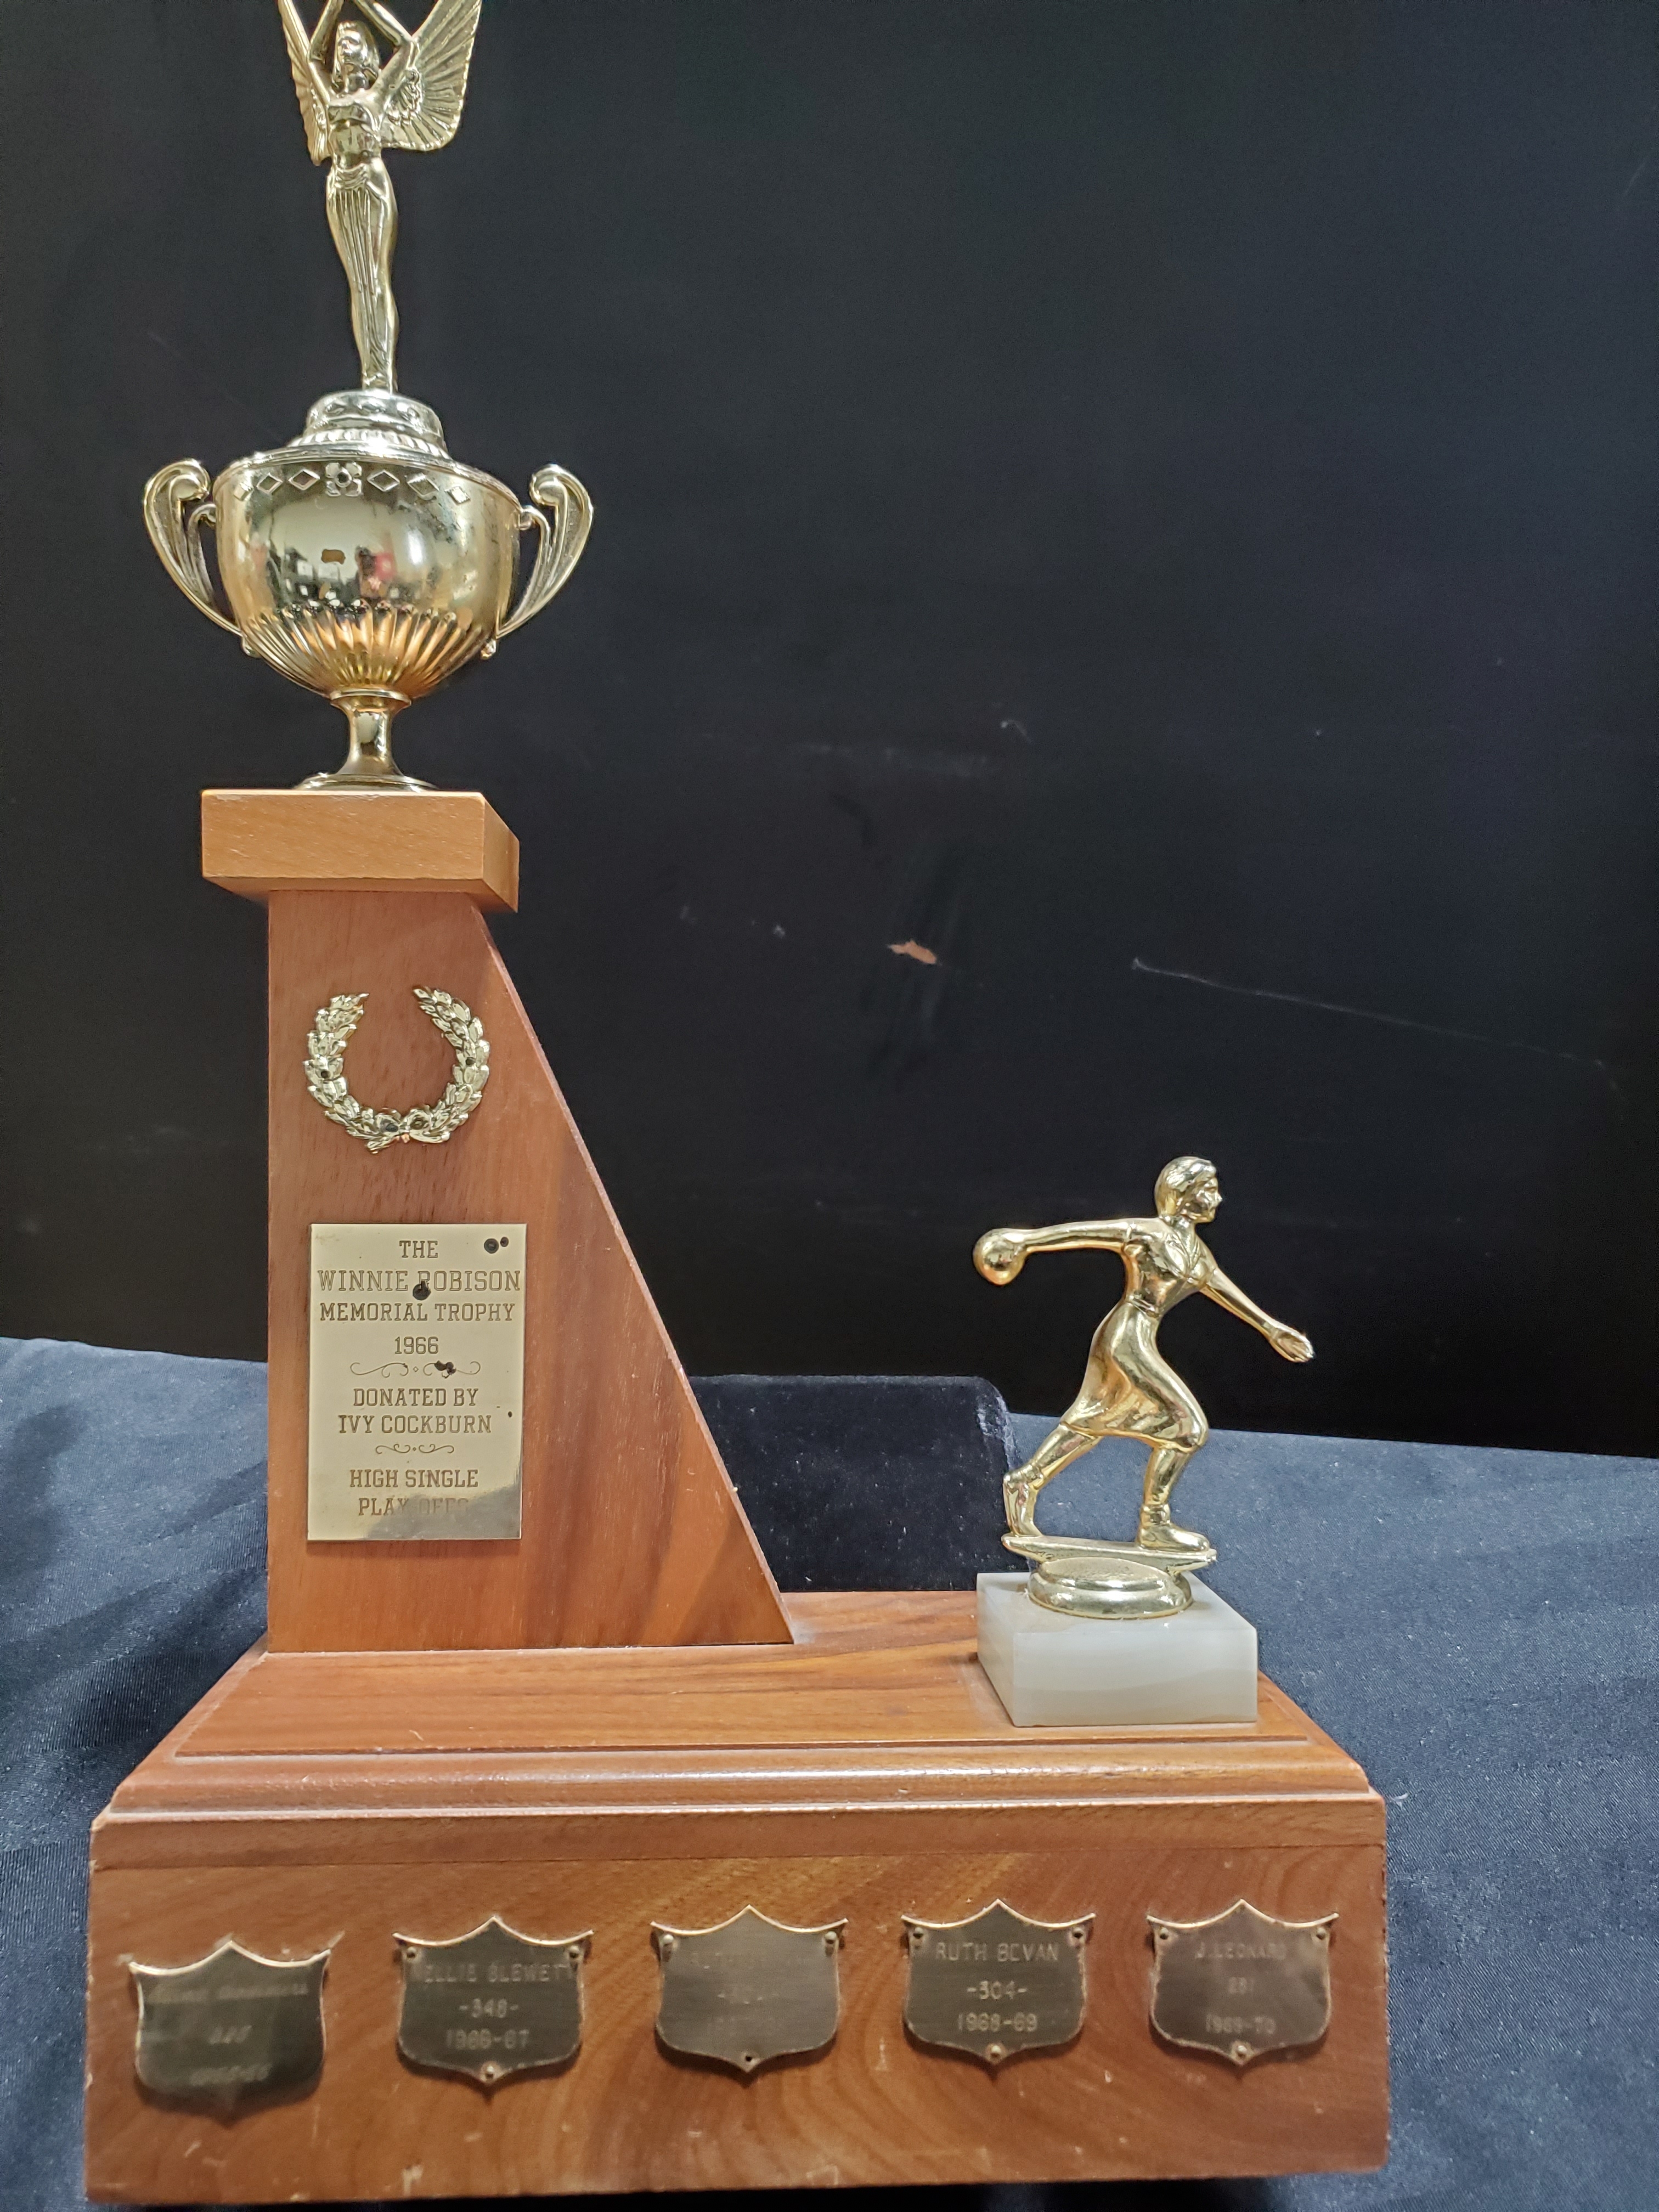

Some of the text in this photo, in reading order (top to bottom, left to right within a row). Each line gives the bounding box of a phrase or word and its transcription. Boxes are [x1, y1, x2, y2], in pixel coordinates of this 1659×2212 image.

[399, 1240, 438, 1259] THE
[318, 1270, 520, 1291] WINNIE ROBISON
[320, 1303, 515, 1321] MEMORIAL TROPHY
[394, 1336, 439, 1355] 1966
[353, 1388, 478, 1407] DONATED BY
[338, 1415, 492, 1434] IVY COCKBURN
[349, 1469, 478, 1488] HIGH SINGLE
[359, 1498, 409, 1516] PLAY
[935, 1942, 988, 1961] RUTH
